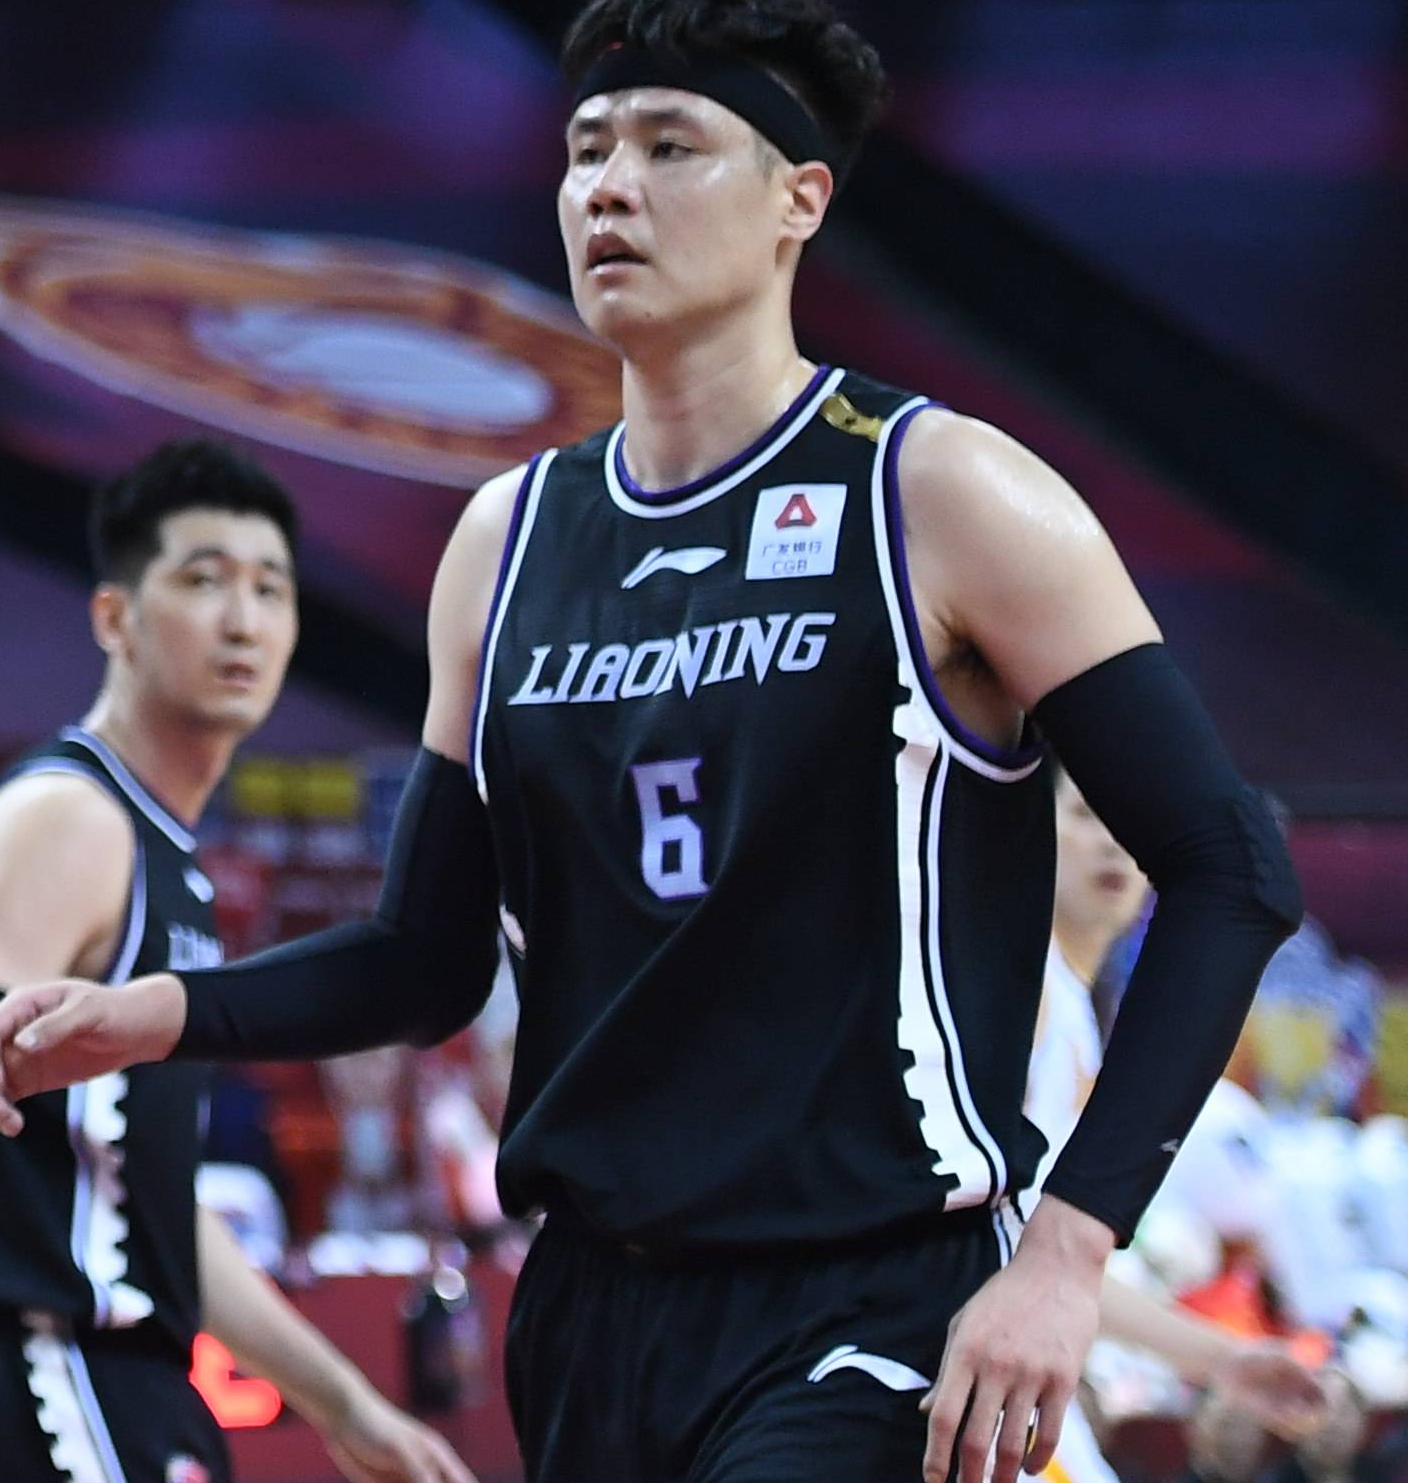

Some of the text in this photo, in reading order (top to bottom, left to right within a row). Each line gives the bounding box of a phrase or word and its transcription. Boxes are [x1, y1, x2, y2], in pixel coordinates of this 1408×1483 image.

[772, 559, 808, 576] CGB
[507, 612, 837, 705] LIAONING
[631, 758, 711, 900] 6
